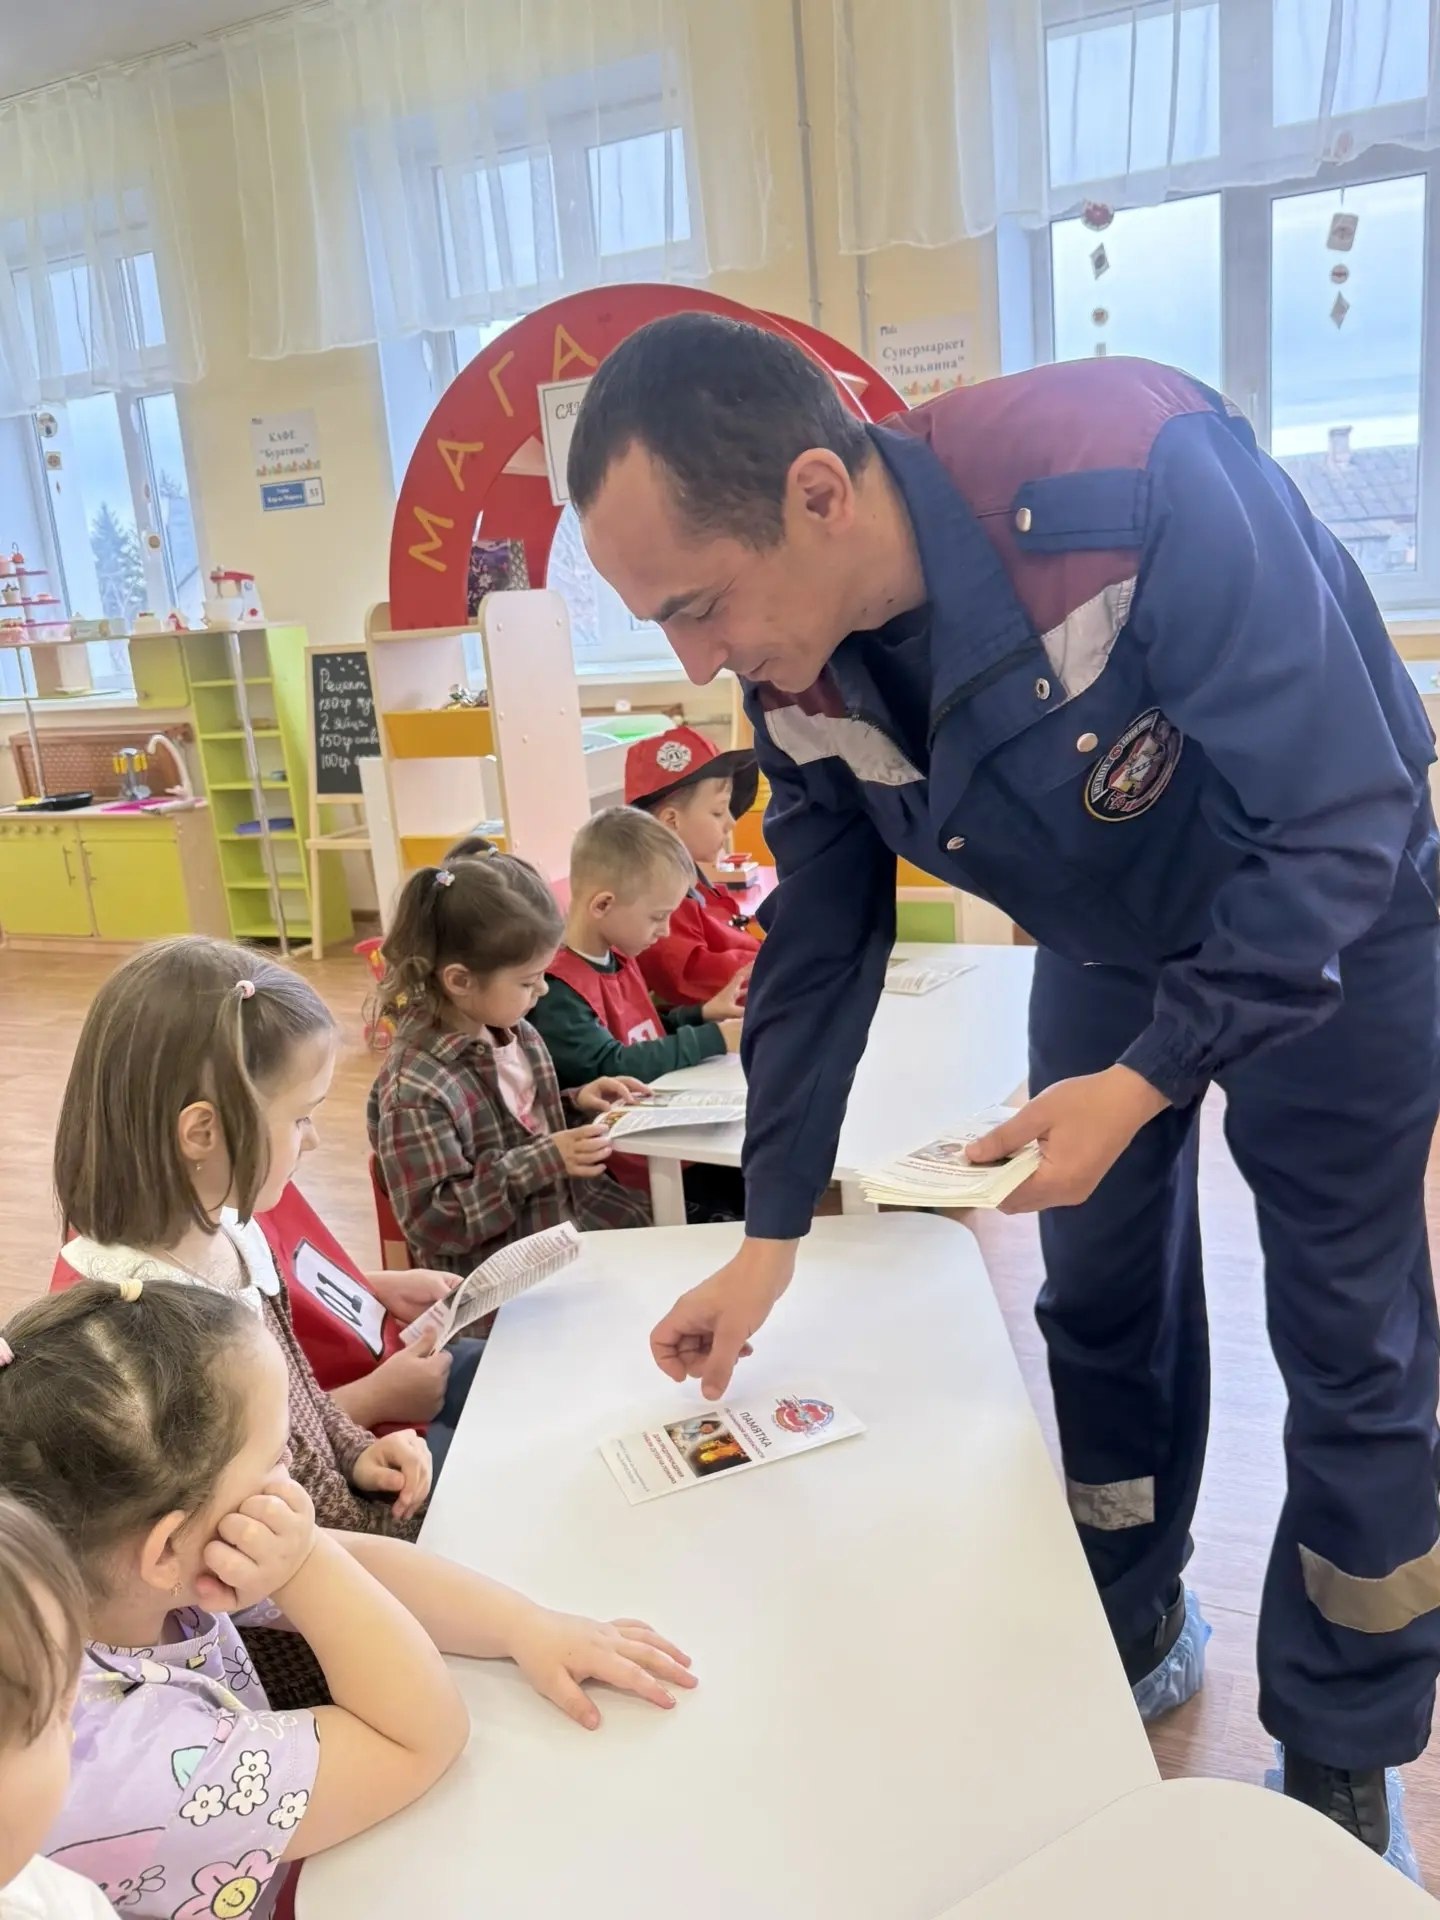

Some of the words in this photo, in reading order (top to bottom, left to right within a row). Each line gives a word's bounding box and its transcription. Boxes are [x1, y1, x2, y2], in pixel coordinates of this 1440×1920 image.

[881, 340, 965, 361] Супермаркет
[884, 356, 965, 376] "Мальвина"
[268, 430, 296, 442] КАФЕ
[319, 668, 369, 693] Рецепт
[320, 713, 330, 731] 2
[740, 1411, 773, 1448] ПАМЯТКА
